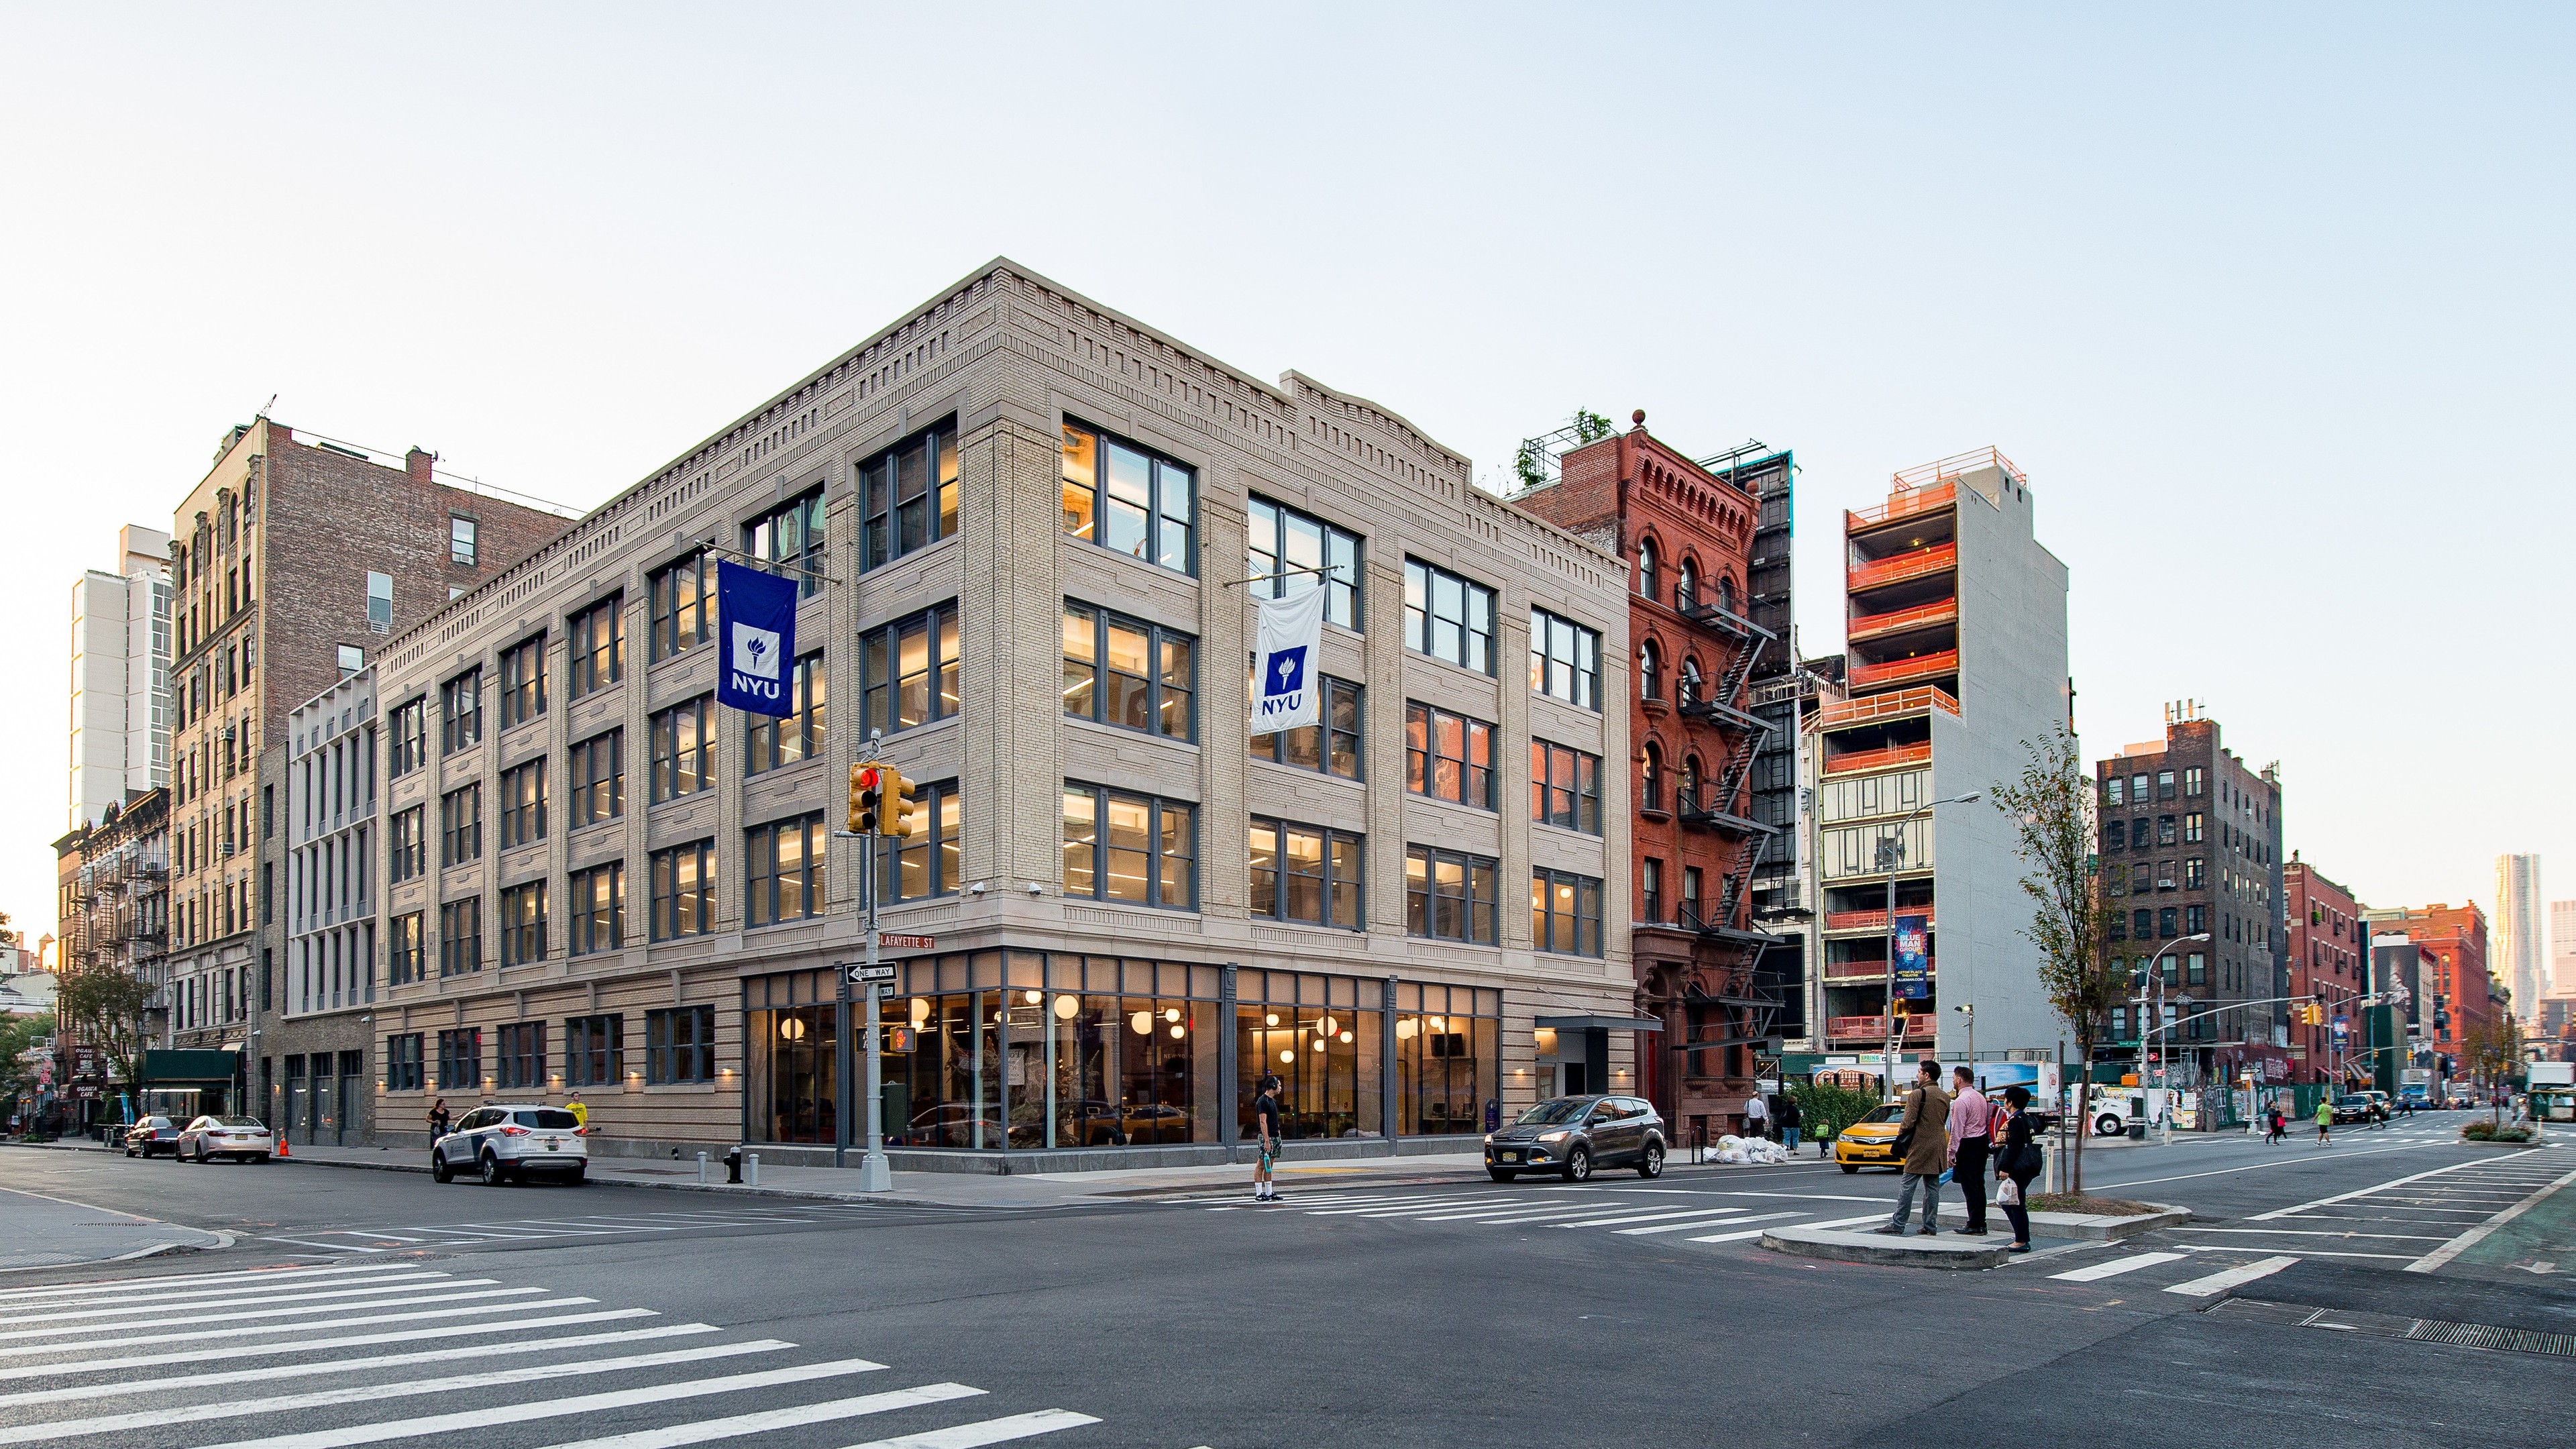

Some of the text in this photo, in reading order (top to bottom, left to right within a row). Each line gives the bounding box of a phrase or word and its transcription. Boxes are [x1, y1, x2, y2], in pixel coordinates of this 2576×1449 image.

[732, 673, 780, 699] NYU
[1262, 693, 1302, 716] NYU
[880, 935, 932, 948] LAFAYETTE ST
[875, 968, 890, 976] WAY
